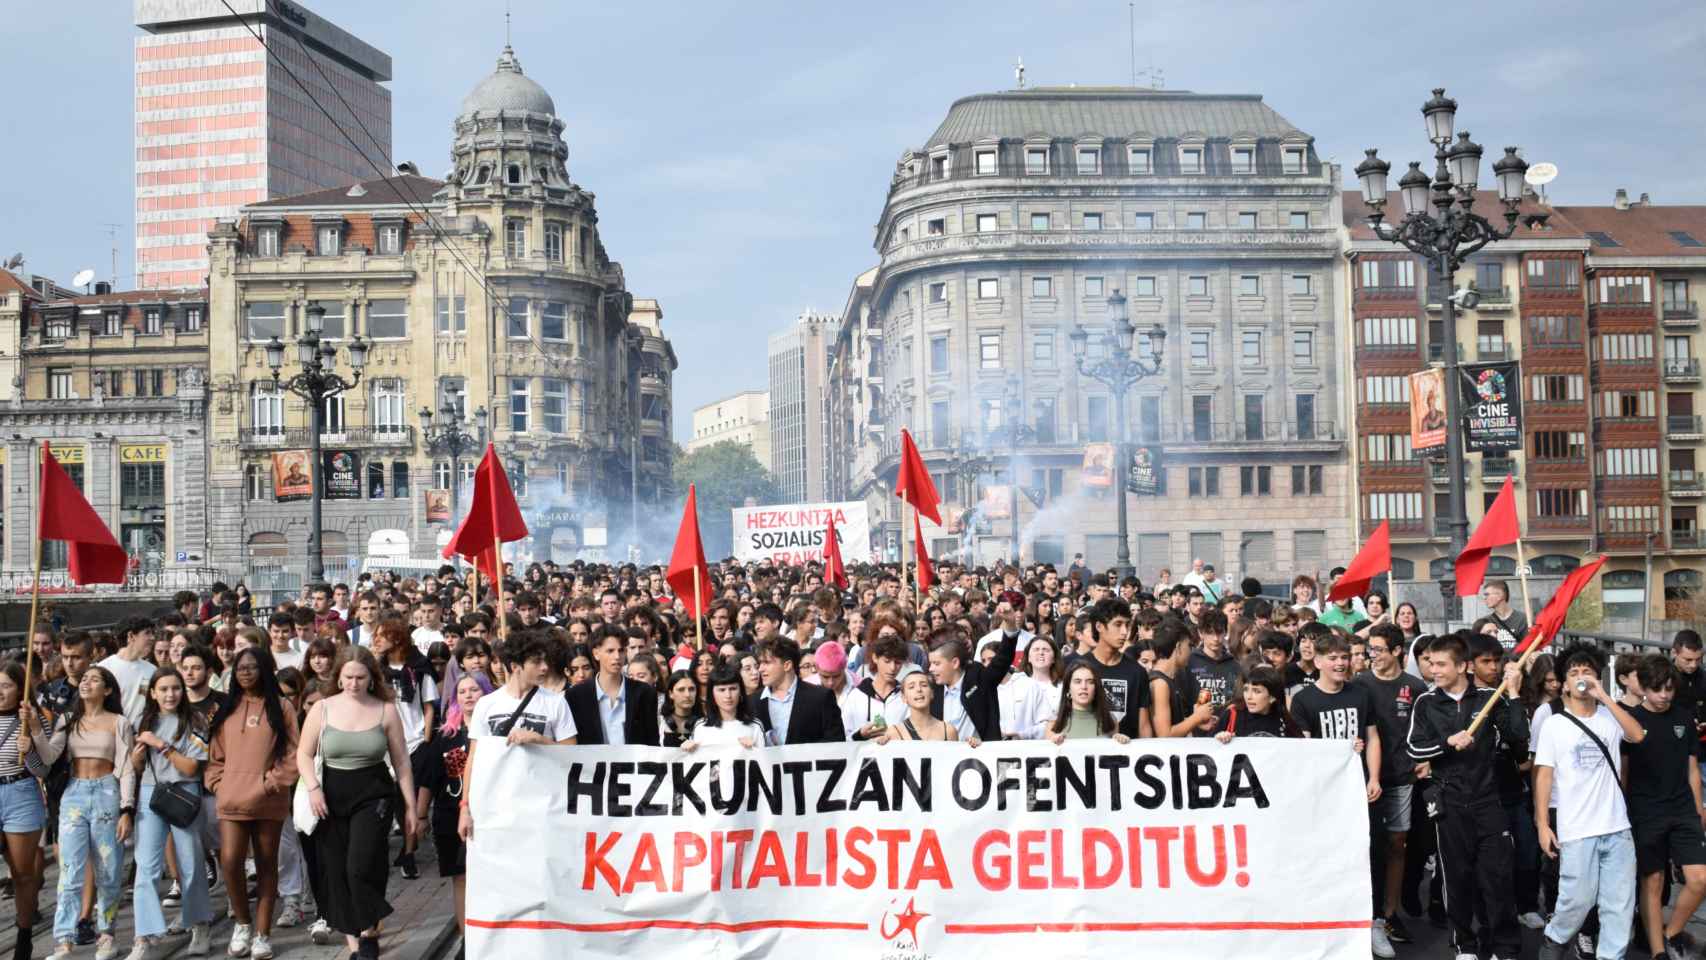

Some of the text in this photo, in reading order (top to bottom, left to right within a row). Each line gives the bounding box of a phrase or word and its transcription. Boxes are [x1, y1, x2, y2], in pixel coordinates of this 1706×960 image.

[1478, 403, 1509, 418] CINE
[1470, 416, 1518, 429] INVISIBLE
[333, 472, 353, 480] CINE
[747, 508, 847, 528] HEZKUNTZA
[567, 753, 1270, 817] HEZKUNTZAN OFENTSIBA
[581, 824, 1250, 896] KAPITALISTA GELDITU!
